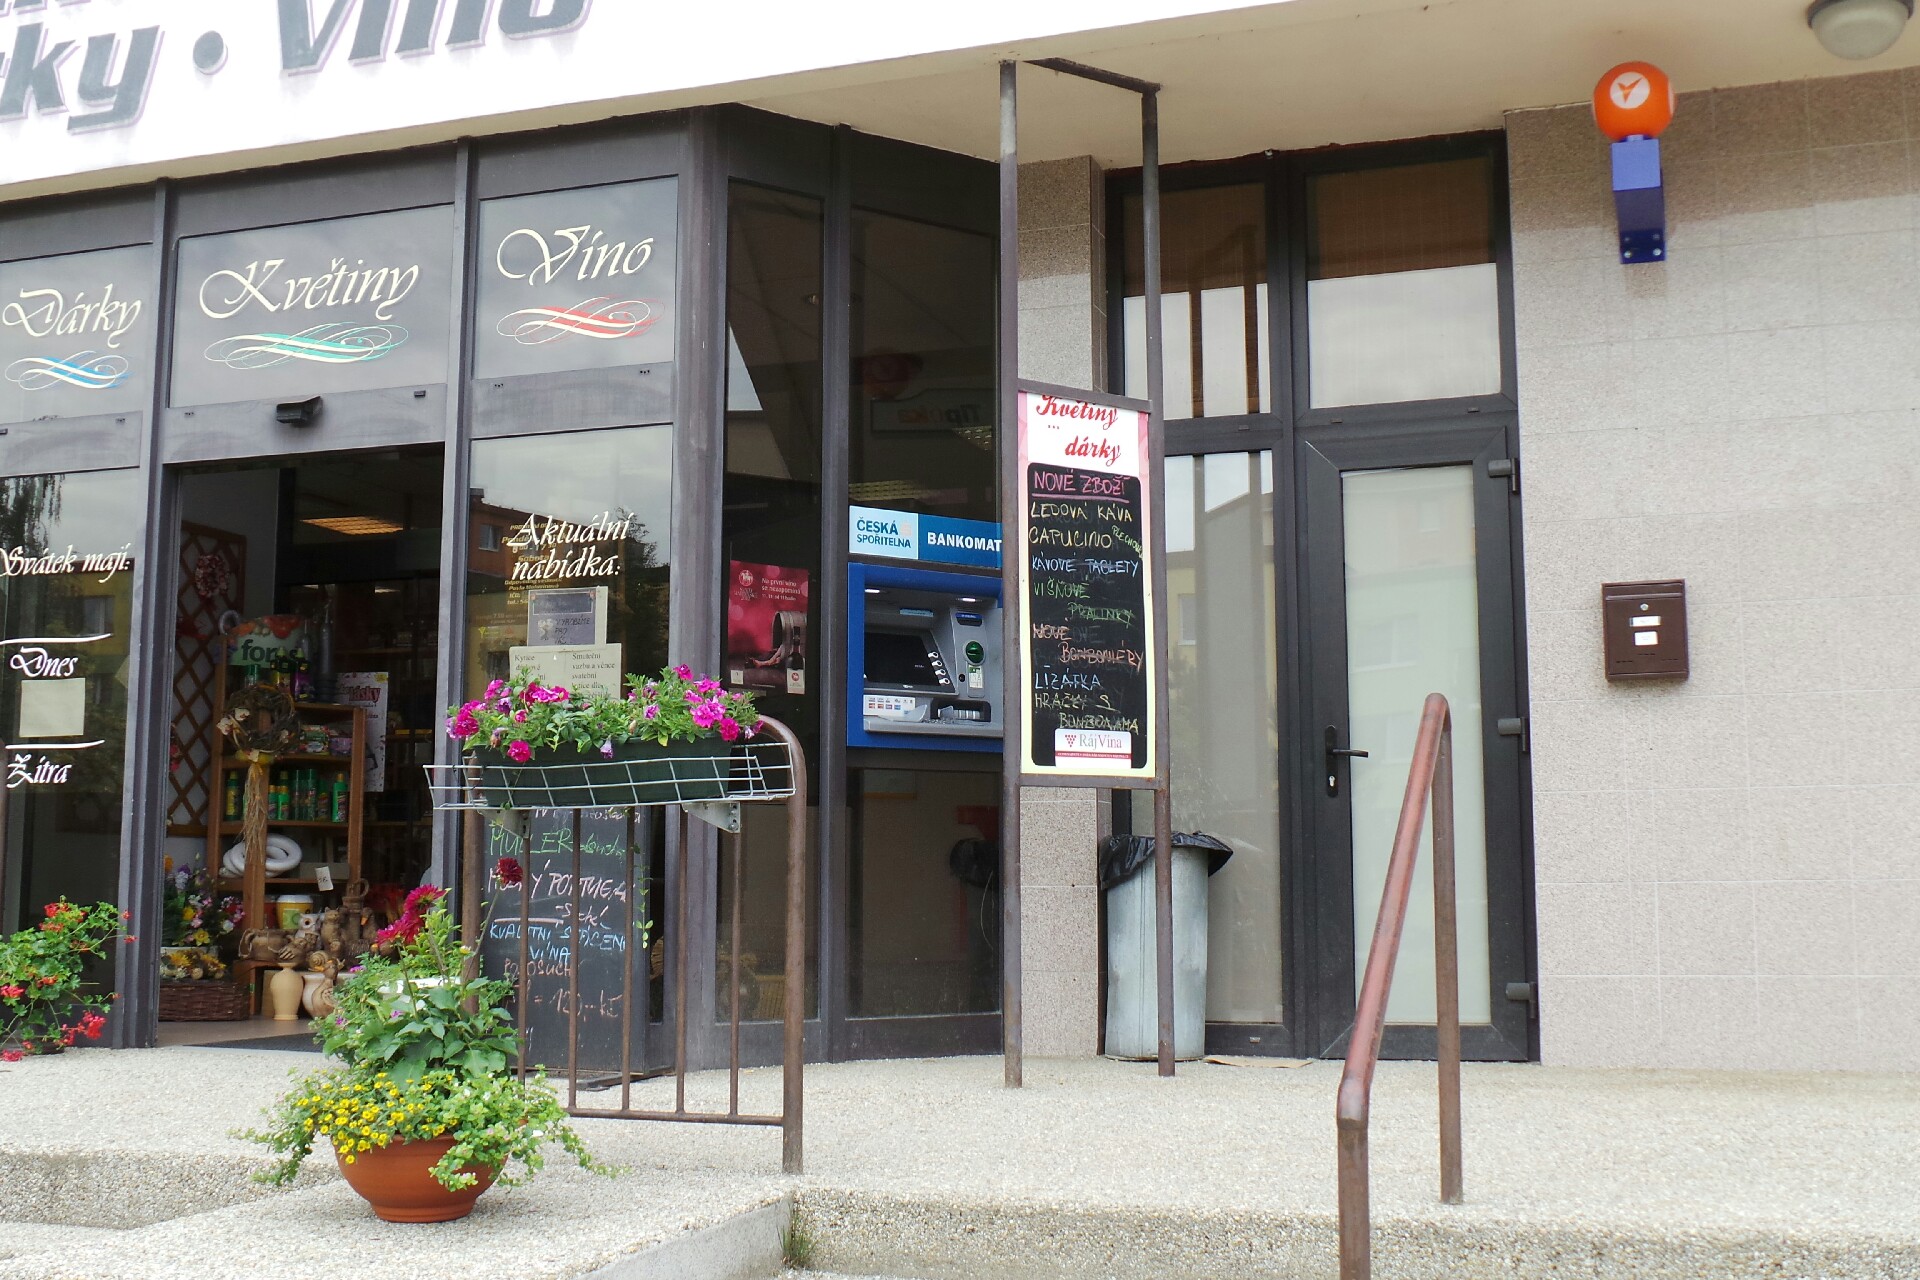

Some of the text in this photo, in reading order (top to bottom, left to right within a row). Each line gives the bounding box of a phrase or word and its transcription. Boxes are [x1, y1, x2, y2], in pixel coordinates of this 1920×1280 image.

[496, 225, 654, 286] Víno
[199, 257, 419, 321] Květiny
[2, 283, 142, 348] Dárky
[1064, 435, 1121, 467] dárky
[1034, 468, 1076, 492] NOVÉ
[856, 516, 899, 536] ČESKÁ
[1030, 501, 1133, 522] LEDOVÁ KÁVA
[507, 510, 635, 547] Aktuální
[856, 533, 912, 549] SPOŘITELNA
[927, 531, 1002, 552] BANKOMAT
[1028, 526, 1112, 549] CAPUCINO
[0, 544, 74, 577] Svátek
[511, 545, 621, 581] nabídka:
[1032, 551, 1078, 573] KÁVOVÉ
[10, 646, 79, 678] Dnes
